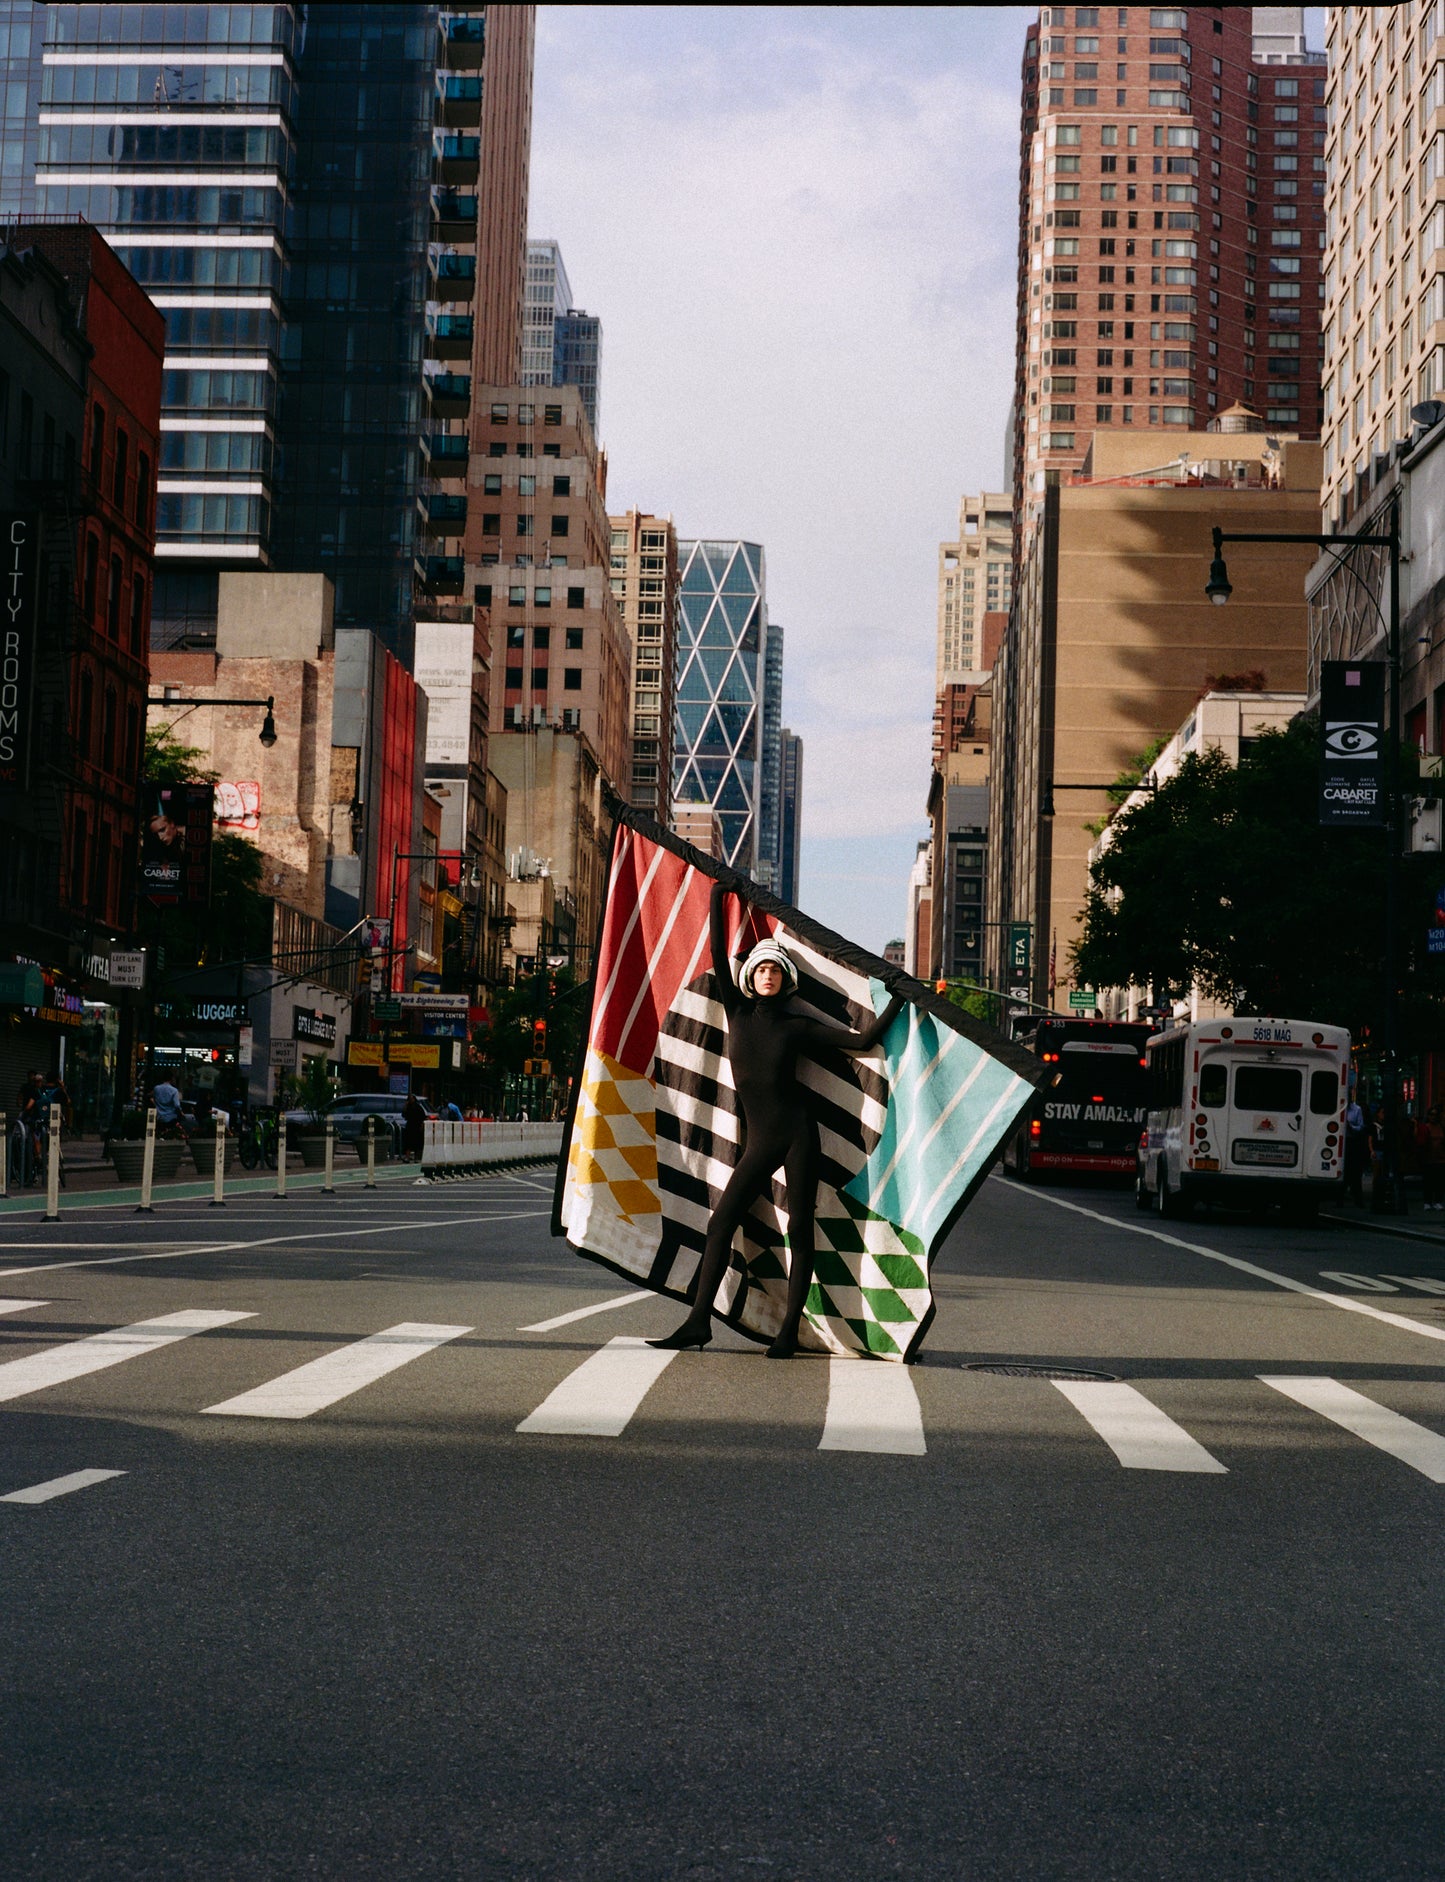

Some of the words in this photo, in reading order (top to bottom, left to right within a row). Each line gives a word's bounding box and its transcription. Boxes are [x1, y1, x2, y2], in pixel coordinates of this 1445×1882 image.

[7, 520, 26, 623] CITY
[0, 631, 20, 761] ROOMS
[1323, 788, 1378, 800] CABARET
[144, 868, 181, 879] CABARET
[1014, 938, 1026, 966] ETA
[117, 965, 136, 973] MUST
[417, 996, 455, 1006] Sightseeing
[445, 1012, 466, 1020] CENTER
[1253, 1027, 1271, 1040] 5618
[1273, 1029, 1292, 1042] MAG
[1043, 1102, 1081, 1120] STAY
